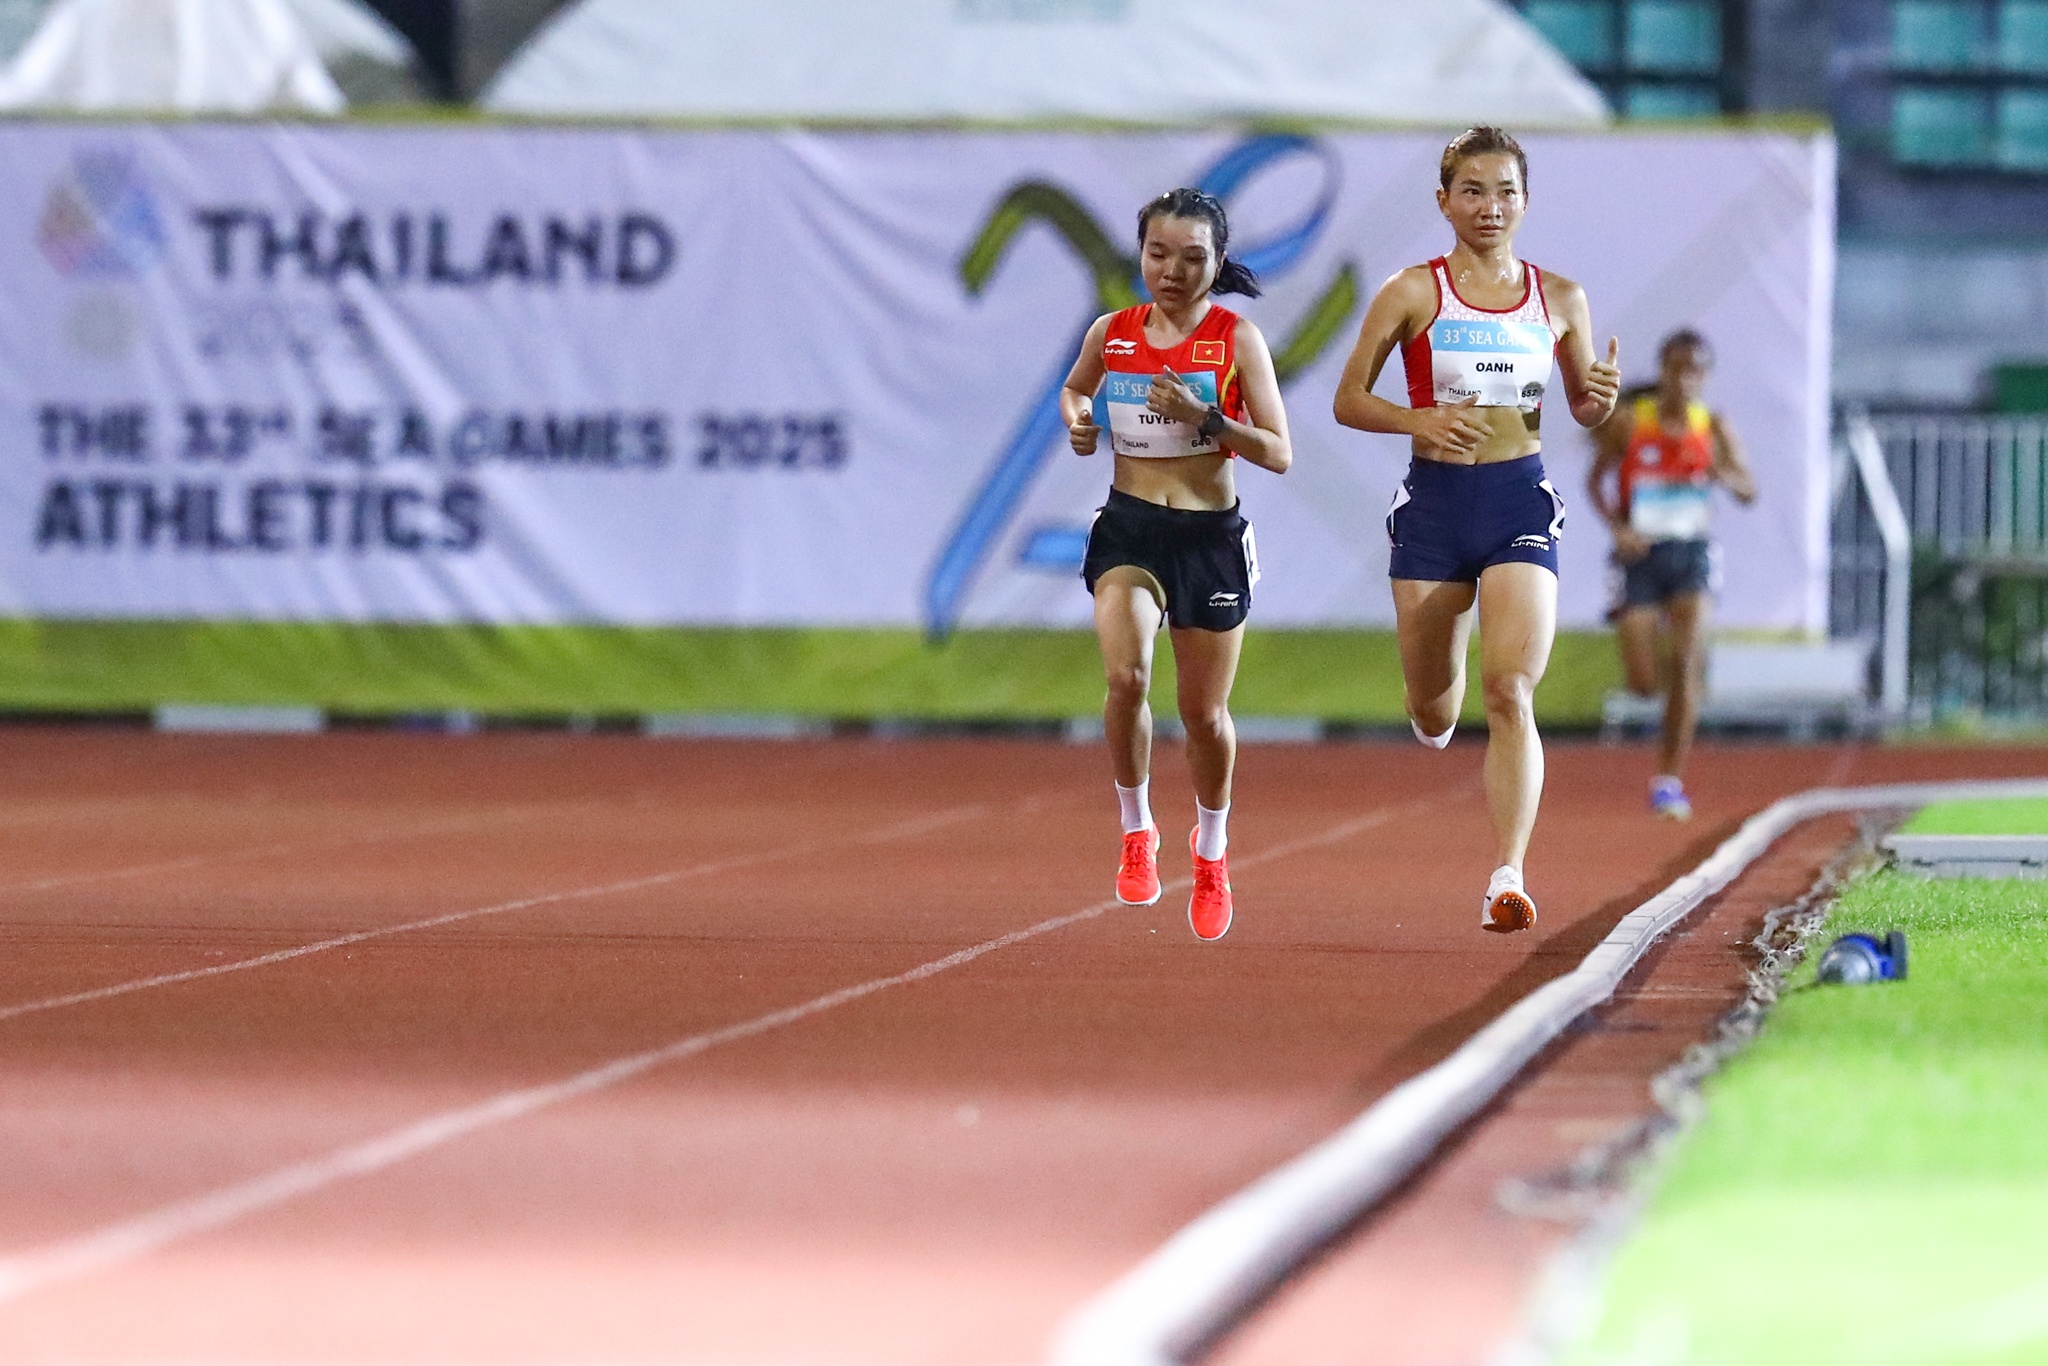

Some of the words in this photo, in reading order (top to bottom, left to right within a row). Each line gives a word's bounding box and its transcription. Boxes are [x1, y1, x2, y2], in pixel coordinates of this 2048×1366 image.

[195, 209, 677, 287] THAILAND
[1468, 330, 1493, 345] SEA
[1475, 362, 1514, 373] OANH
[1521, 388, 1538, 398] 652
[39, 404, 150, 460] THE
[316, 407, 431, 463] SEA
[451, 409, 669, 469] GAMES
[694, 411, 851, 469] 2025
[38, 478, 487, 551] ATHLETICS
